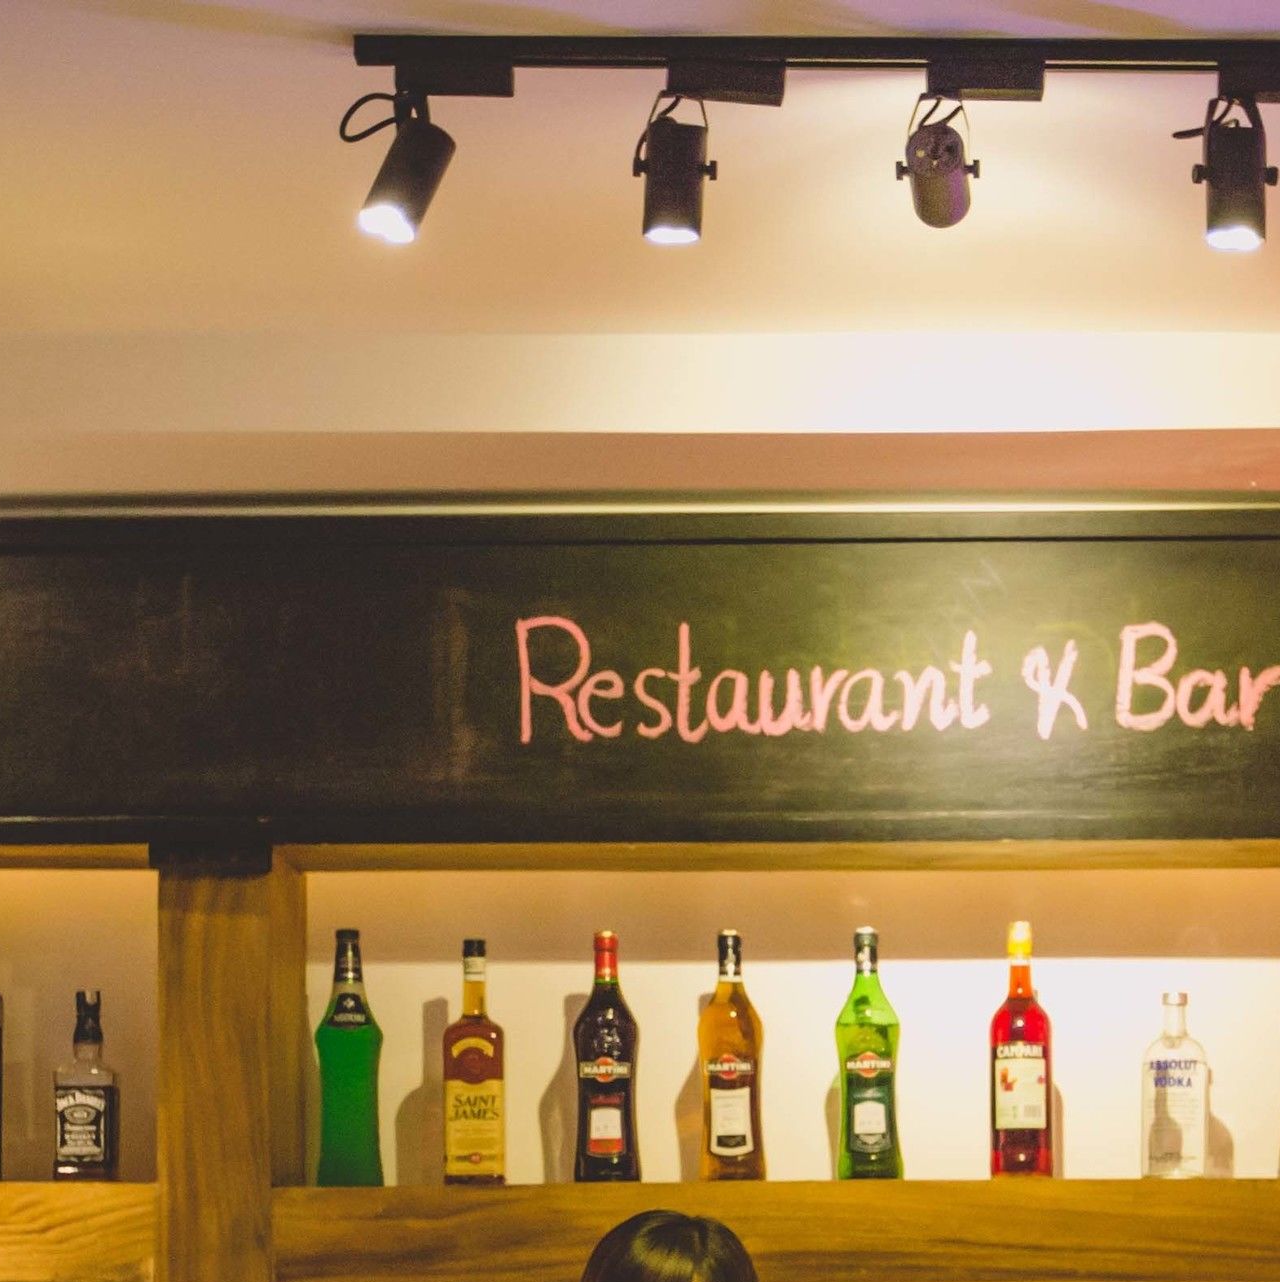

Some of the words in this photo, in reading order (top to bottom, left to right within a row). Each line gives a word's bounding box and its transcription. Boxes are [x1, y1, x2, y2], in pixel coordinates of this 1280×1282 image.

[516, 615, 994, 744] Restaurant
[1149, 1059, 1198, 1071] ABSOLUT
[453, 1094, 497, 1107] SAINT
[449, 1107, 501, 1121] JAMES
